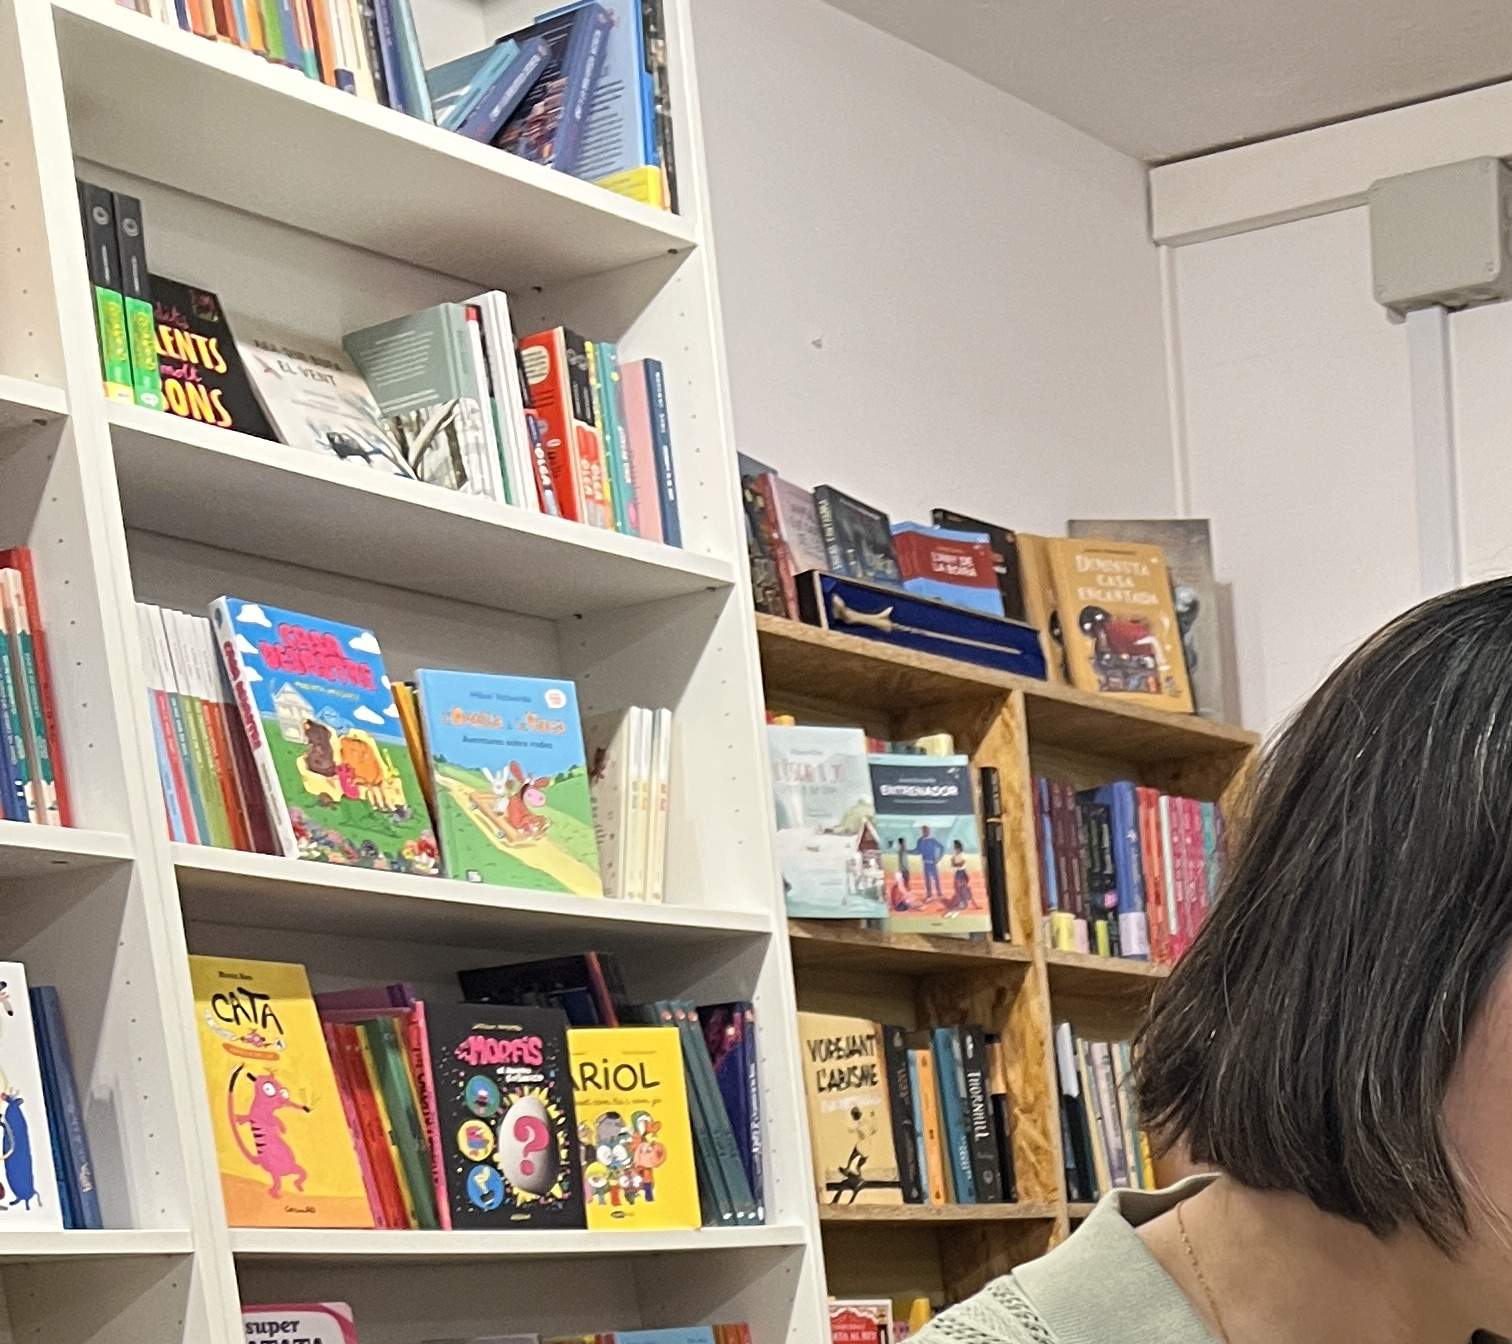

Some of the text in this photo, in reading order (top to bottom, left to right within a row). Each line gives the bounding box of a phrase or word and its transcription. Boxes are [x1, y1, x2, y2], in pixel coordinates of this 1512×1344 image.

[211, 986, 284, 1035] CATA
[967, 1070, 991, 1142] THORNHILL
[245, 1320, 301, 1338] super
